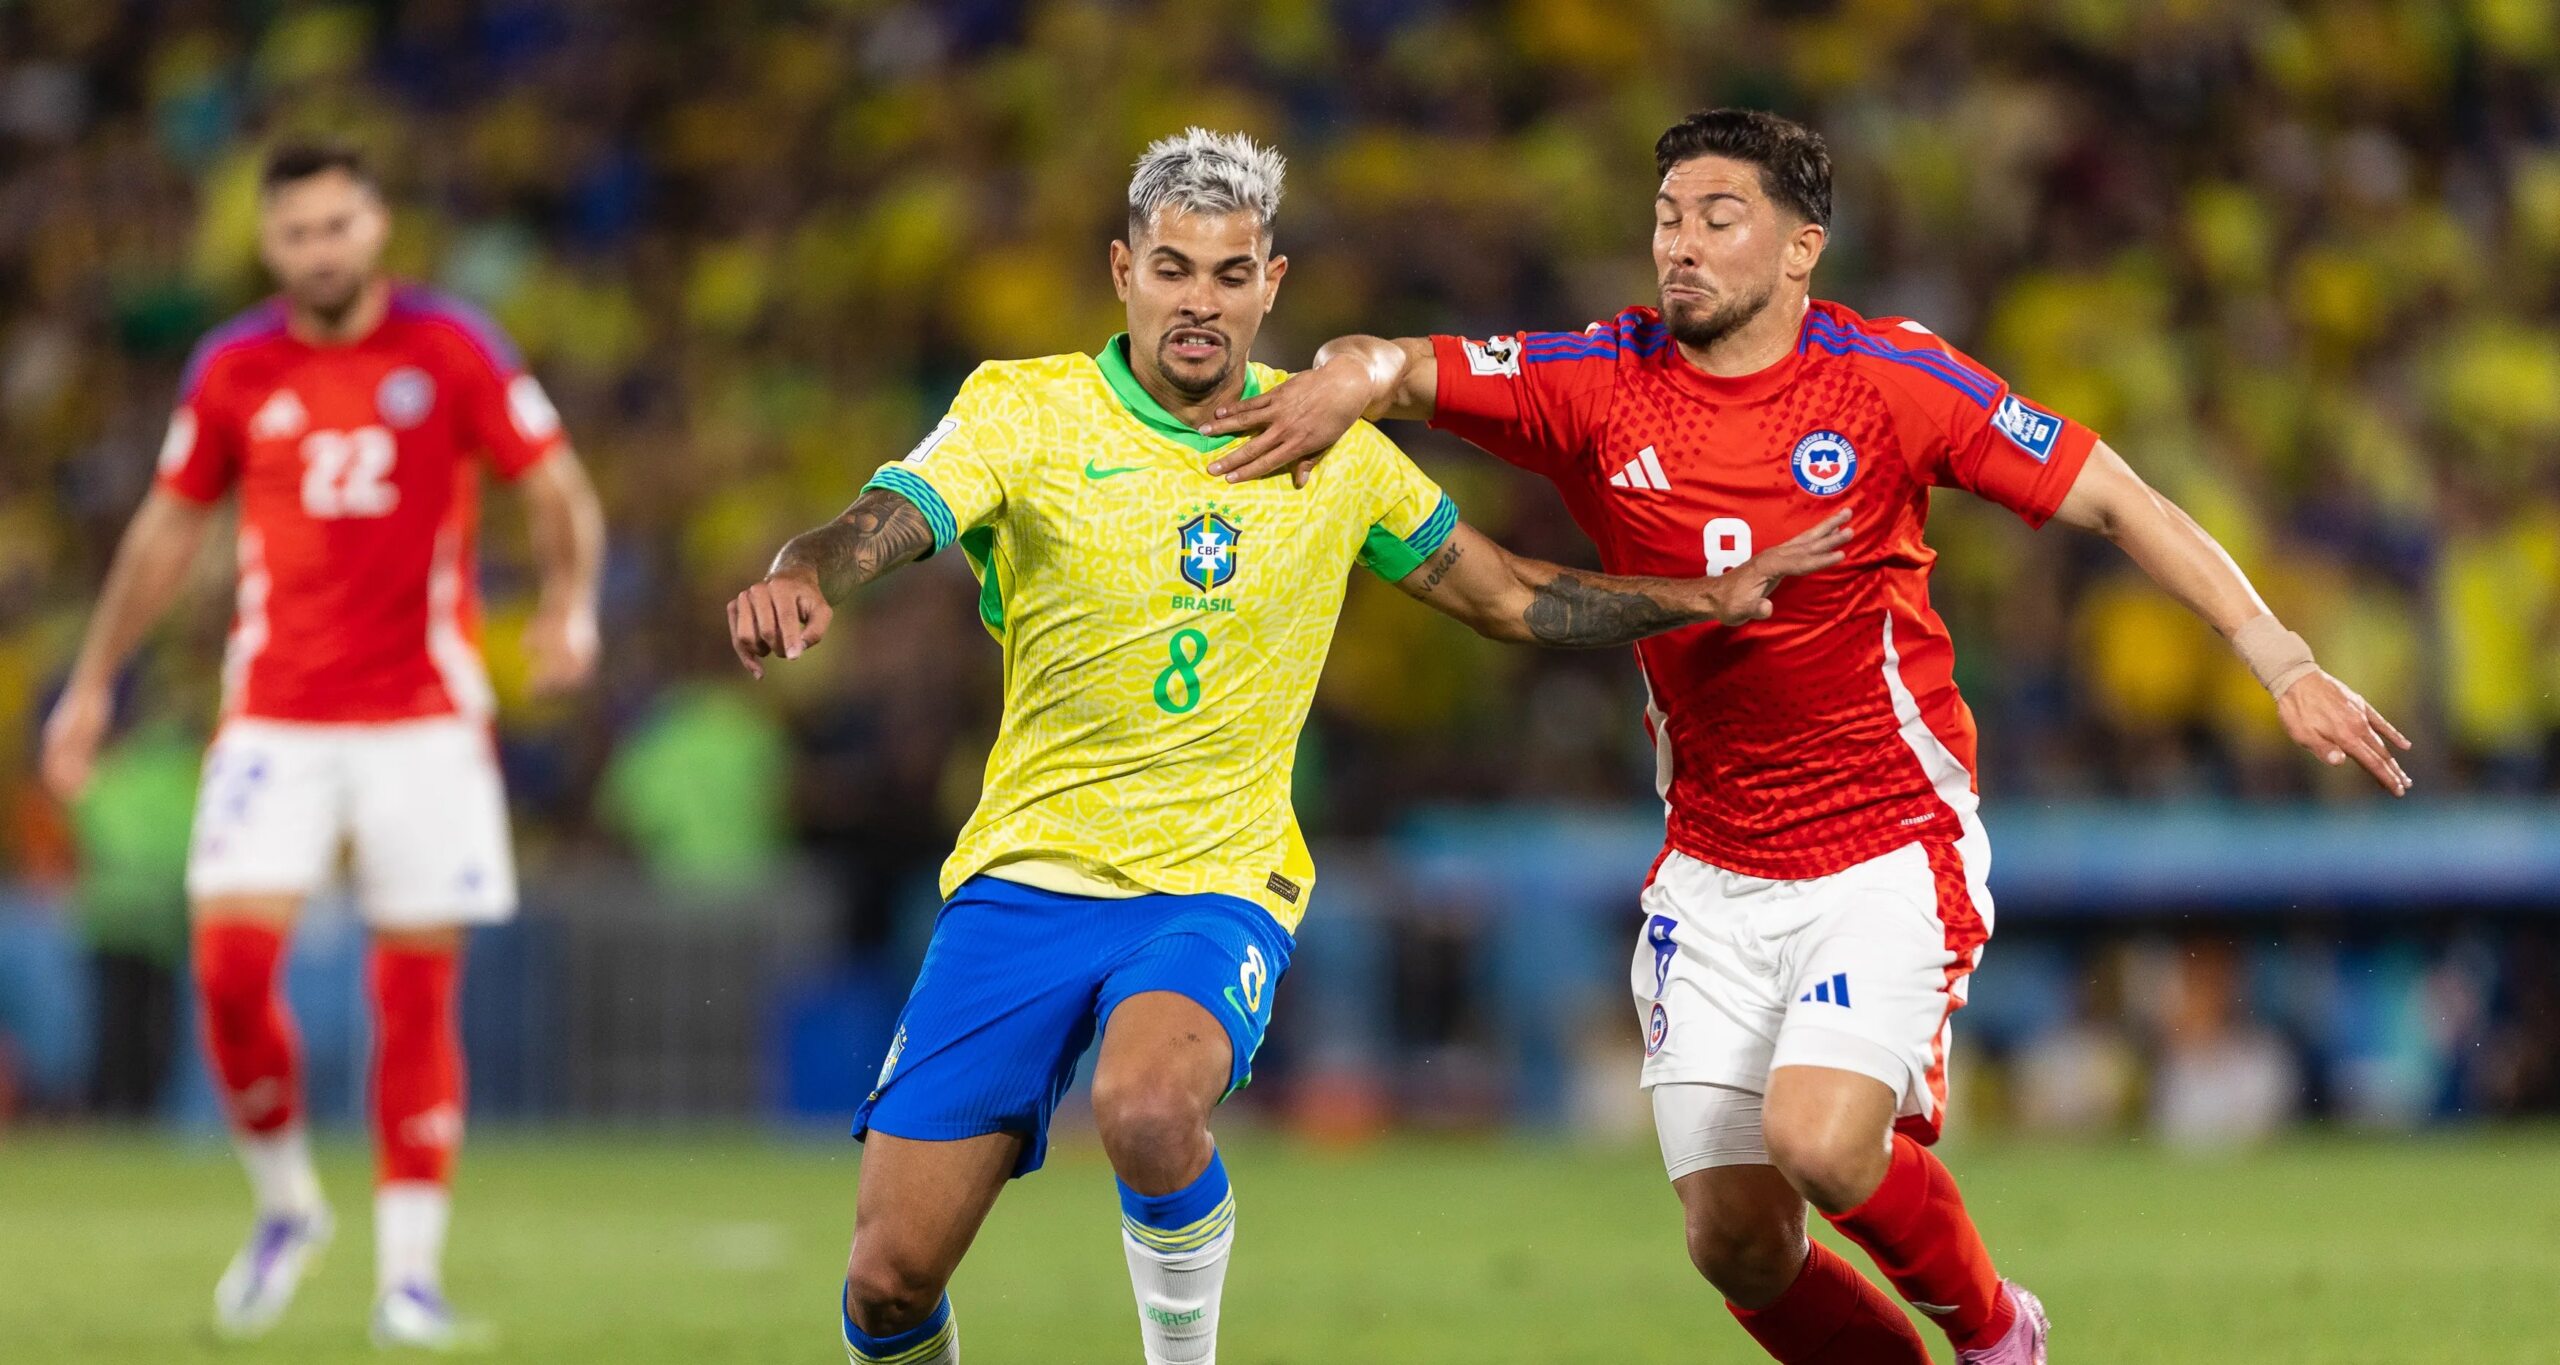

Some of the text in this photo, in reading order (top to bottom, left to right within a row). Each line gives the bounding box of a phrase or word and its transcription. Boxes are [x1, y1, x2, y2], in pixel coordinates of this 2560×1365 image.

[301, 427, 399, 518] 22
[1197, 545, 1220, 556] CBF
[1702, 517, 1753, 577] 8
[1171, 595, 1236, 613] BRASIL
[1153, 628, 1208, 714] 8
[1240, 944, 1267, 1013] 8
[1144, 1302, 1207, 1326] BRASIL
